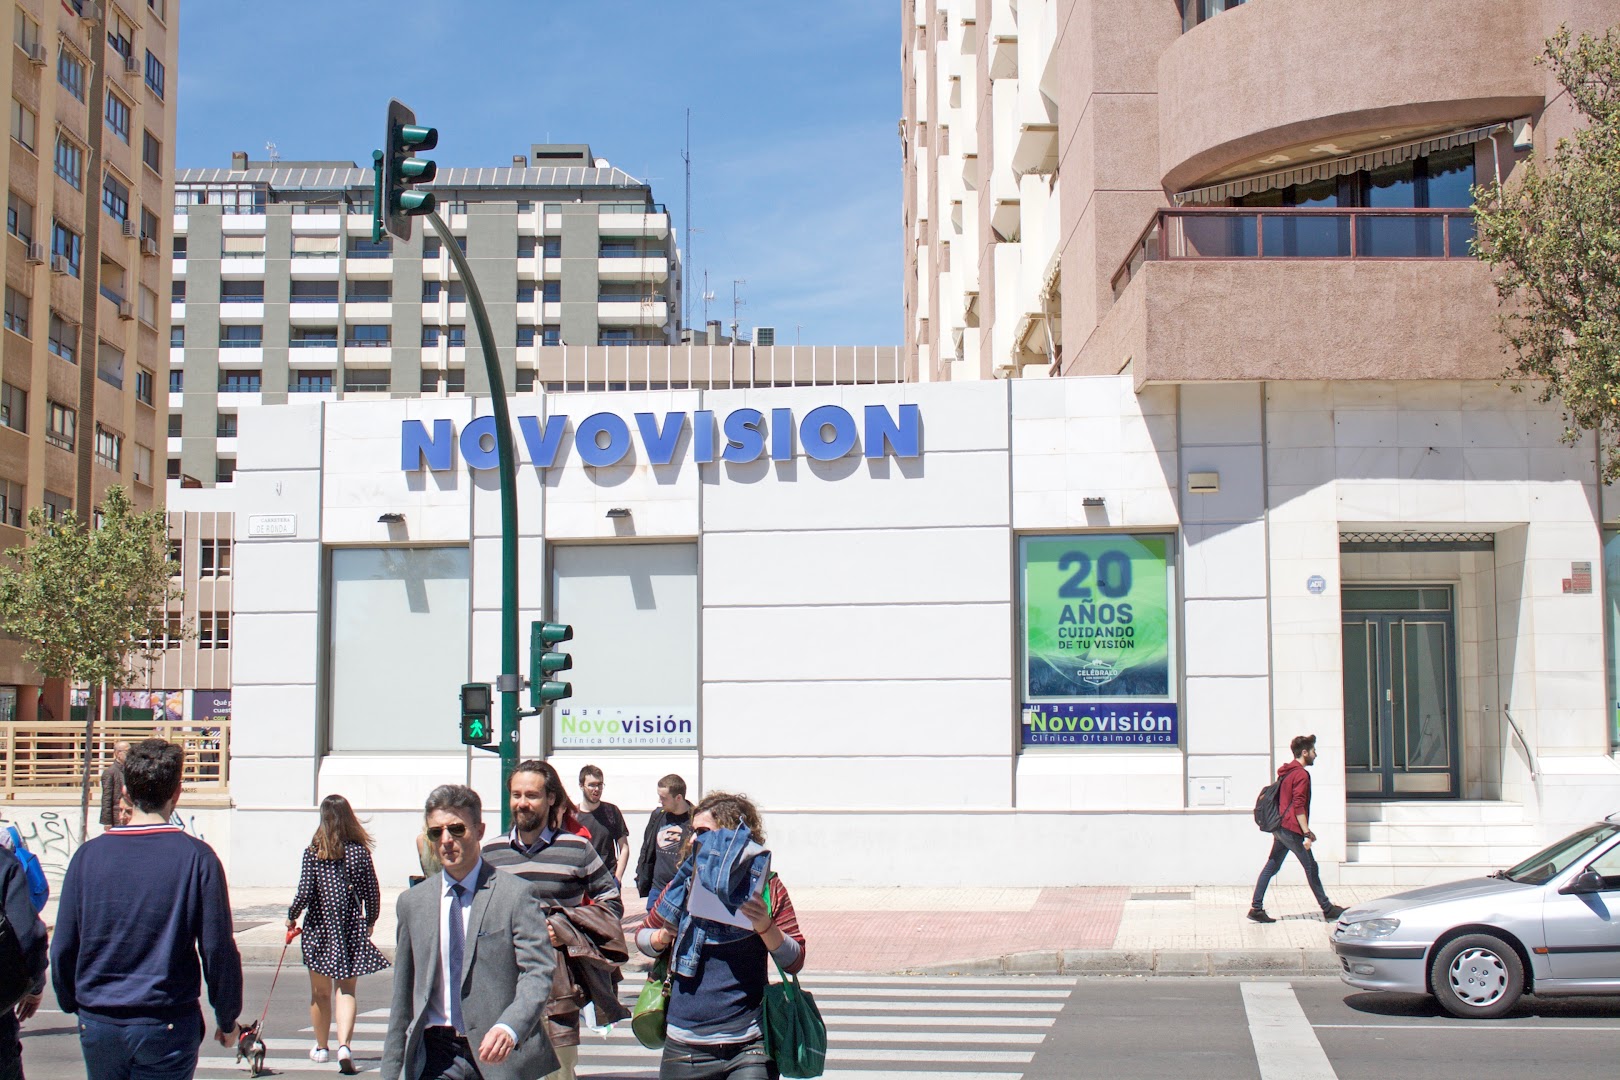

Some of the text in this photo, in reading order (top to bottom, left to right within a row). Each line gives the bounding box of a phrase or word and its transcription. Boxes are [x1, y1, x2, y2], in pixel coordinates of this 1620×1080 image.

[401, 404, 919, 471] NOVOVISION
[256, 524, 288, 533] DE RONDA
[1058, 550, 1132, 598] 20
[1058, 598, 1133, 625] AÑOS
[1058, 626, 1134, 638] CUIDANDO
[1058, 637, 1134, 649] DE TU VISIÓN
[1077, 668, 1118, 676] CELÉBRALO
[561, 715, 692, 734] Novovisión
[1030, 711, 1172, 731] Novovisión
[562, 736, 691, 744] Clínica Oftalmológica
[1031, 733, 1171, 743] Clínica Oftalmológica
